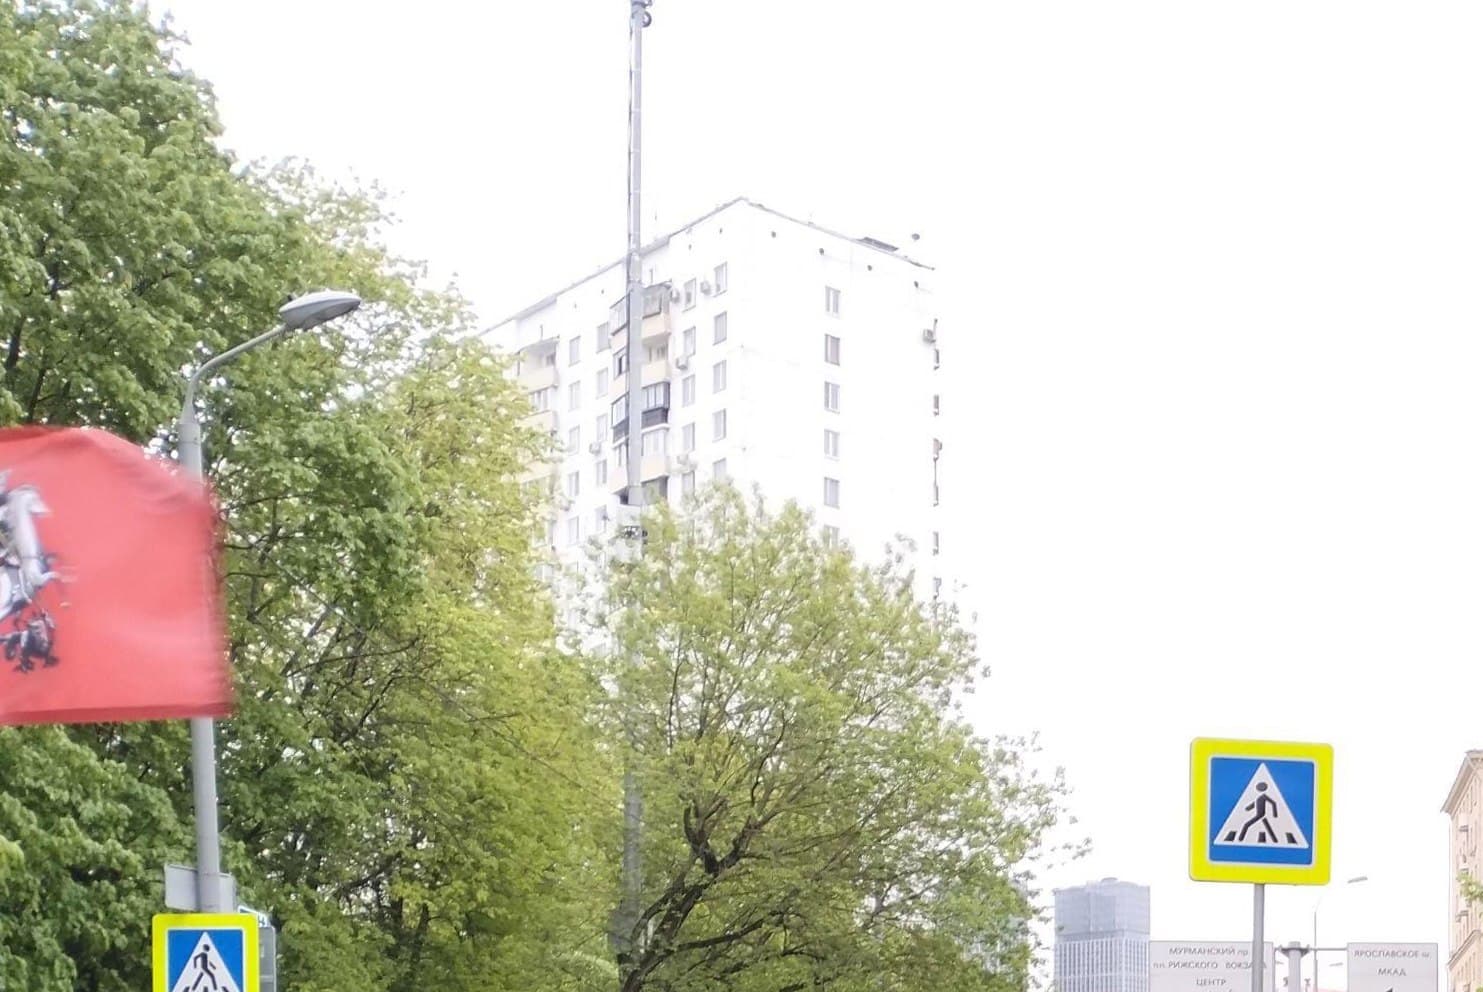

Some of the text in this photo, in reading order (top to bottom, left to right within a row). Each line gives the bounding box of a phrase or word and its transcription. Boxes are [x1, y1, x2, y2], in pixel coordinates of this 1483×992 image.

[1169, 946, 1235, 955] МУРМАНСКИЙ
[1354, 950, 1419, 958] ЯРОСЛАВСКОЕ
[1168, 961, 1218, 969] РИЖСКОГО
[1377, 967, 1407, 976] МКАД
[1196, 978, 1227, 987] ЦЕНТР
